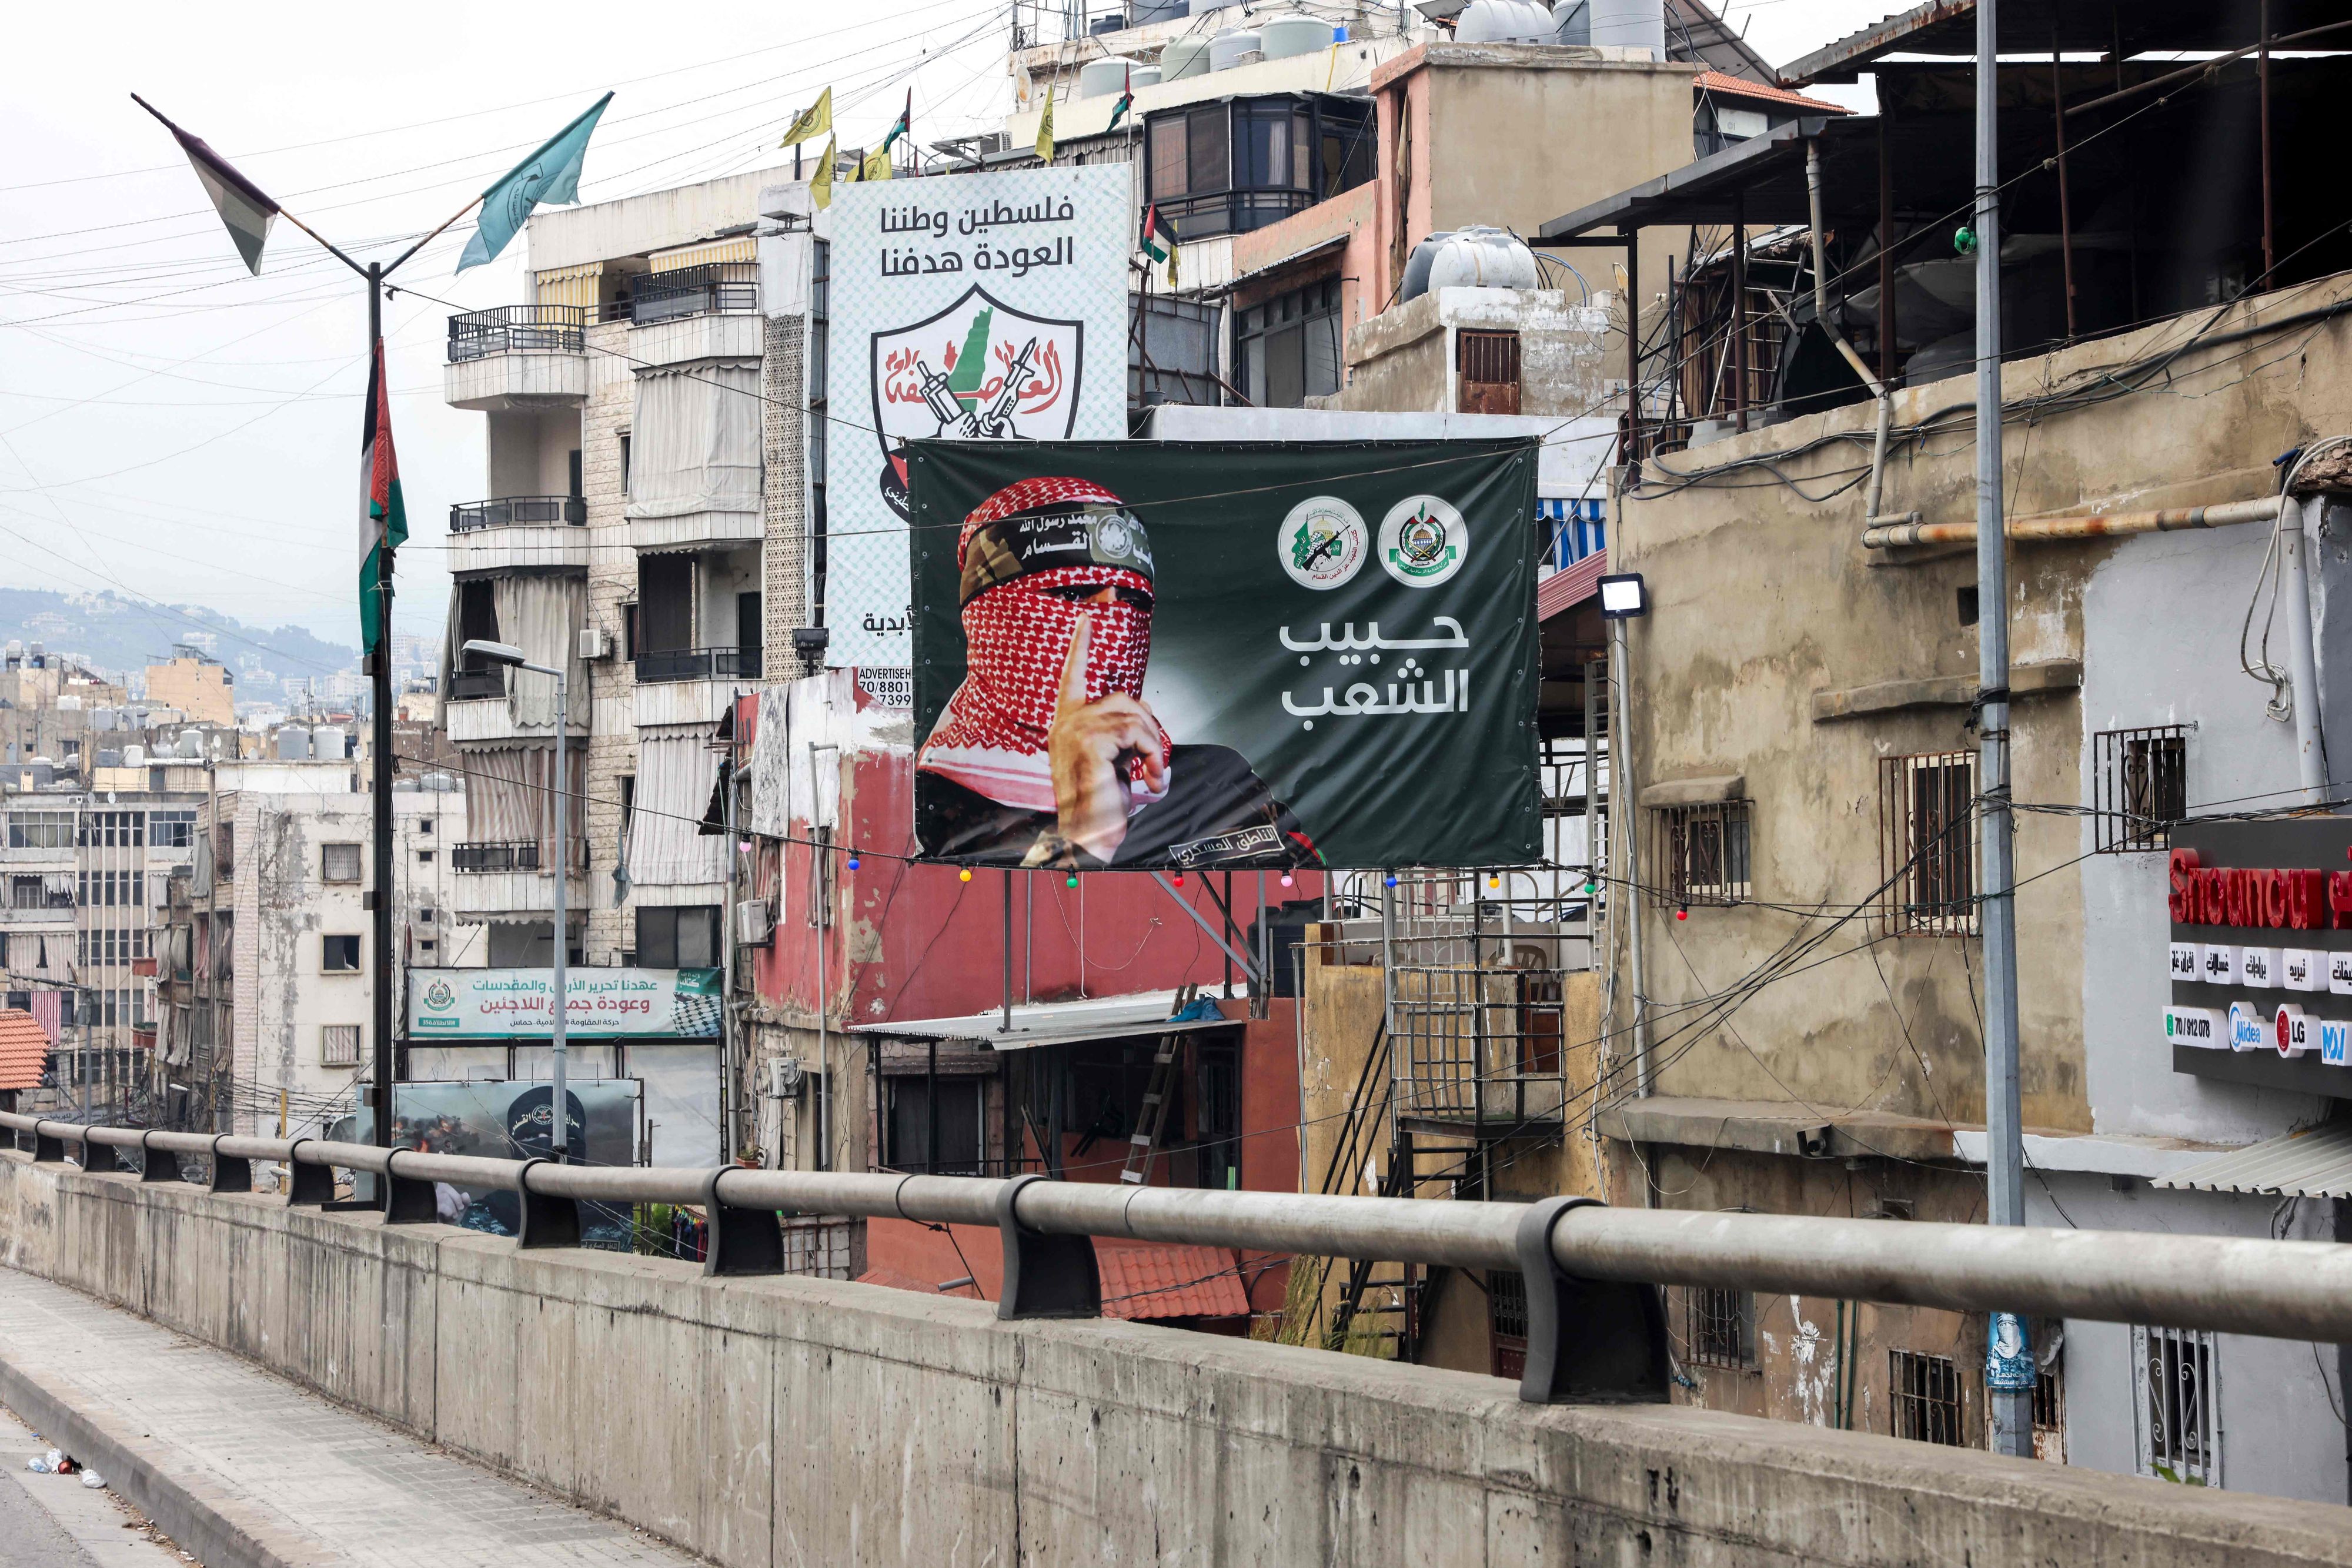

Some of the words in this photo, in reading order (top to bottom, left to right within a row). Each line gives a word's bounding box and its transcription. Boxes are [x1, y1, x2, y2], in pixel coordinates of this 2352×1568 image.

[880, 206, 948, 238] وطننا
[958, 195, 1074, 235] فلسطين
[881, 247, 963, 277] هدفنا
[974, 236, 1073, 278] العودة
[1020, 519, 1034, 533] الله
[1037, 516, 1065, 533] رسول
[1067, 513, 1098, 525] محمد
[1021, 531, 1093, 560] القسام
[1281, 658, 1469, 731] الشعب
[1237, 828, 1277, 851] الناطق
[2246, 955, 2266, 980] برادات
[2290, 958, 2306, 982] تبريد
[2333, 961, 2352, 986] يفات
[473, 979, 546, 994] والمقدسات
[588, 979, 619, 994] تحرير
[621, 979, 657, 992] عهدنا
[480, 997, 544, 1014] اللاجئين
[597, 997, 650, 1014] وعودة
[570, 1018, 601, 1027] المقاومة
[2236, 1021, 2260, 1043] Midea
[2292, 1021, 2305, 1043] LG
